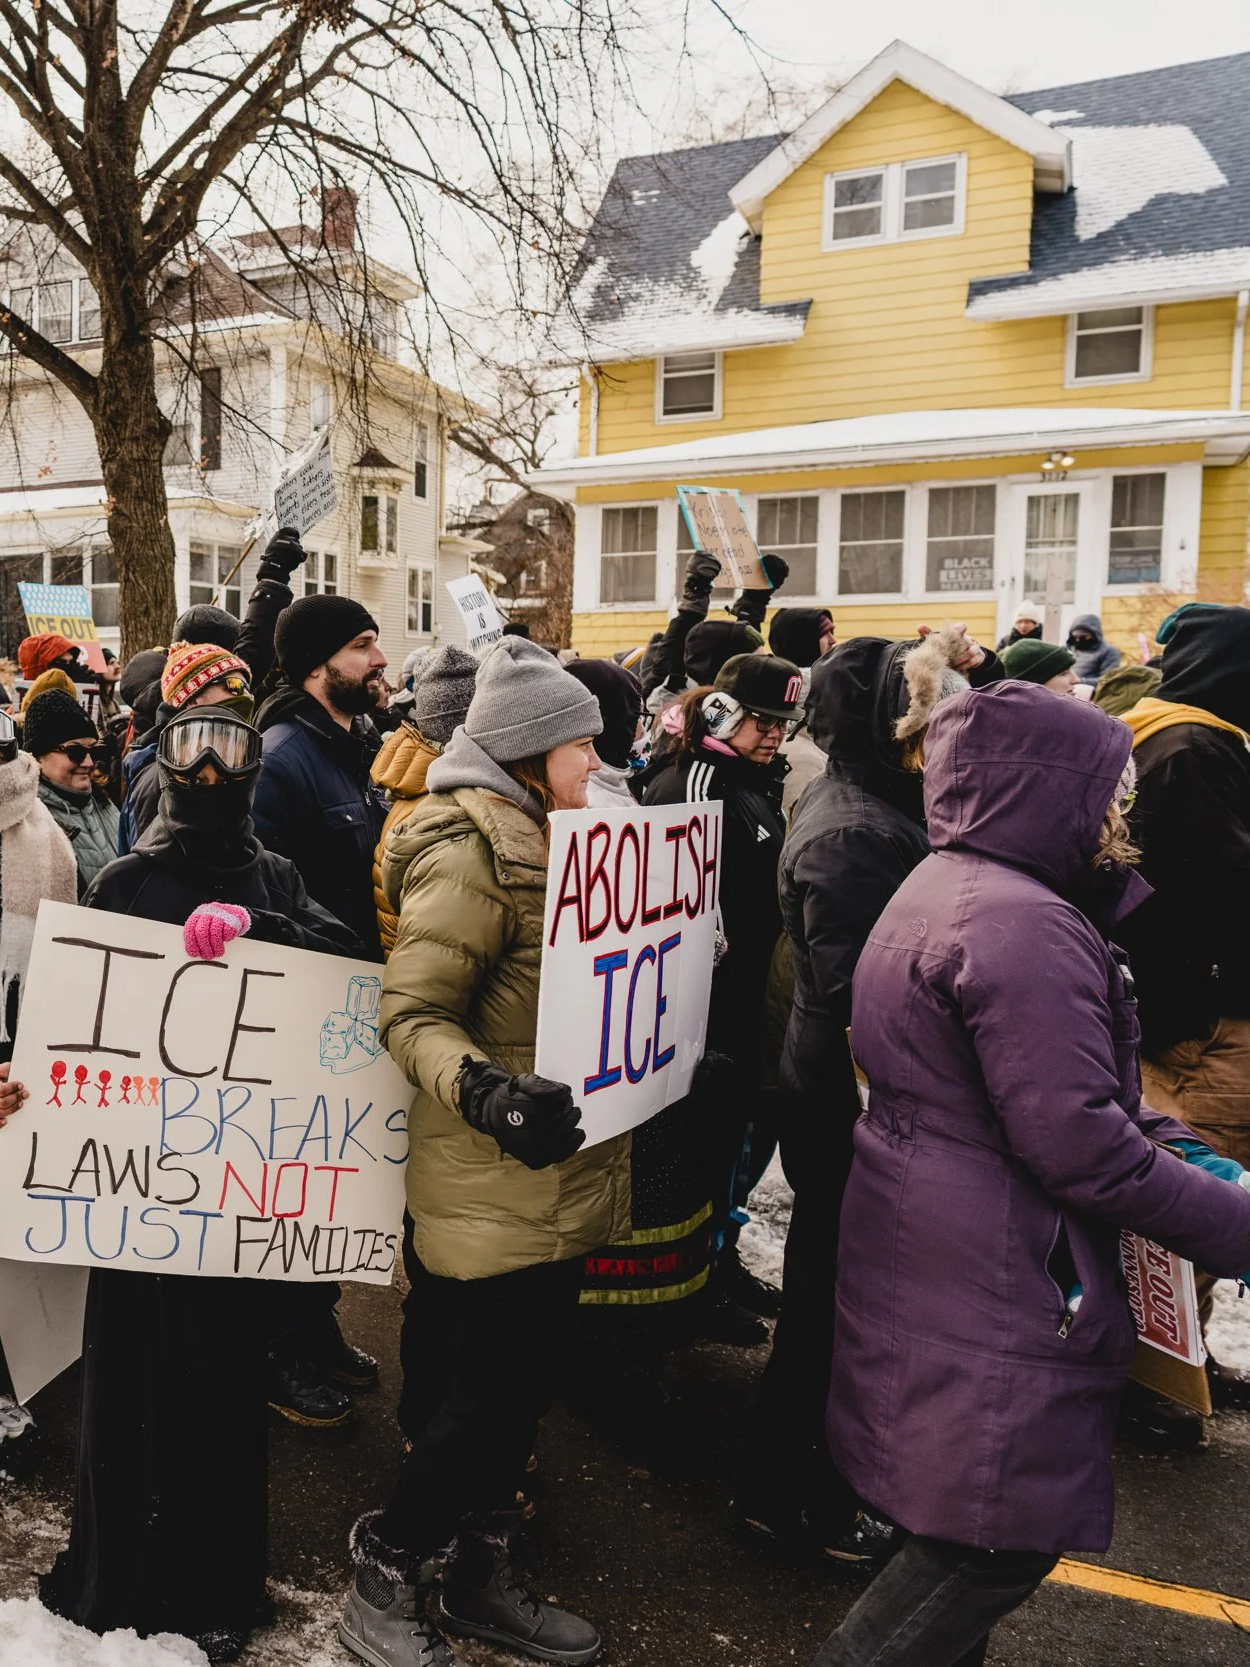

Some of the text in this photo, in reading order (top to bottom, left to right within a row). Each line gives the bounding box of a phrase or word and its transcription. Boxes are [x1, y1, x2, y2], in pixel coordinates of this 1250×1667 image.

[943, 557, 990, 569] BLACK
[946, 569, 987, 580] LIVES
[28, 616, 94, 640] ICE OUT
[458, 590, 488, 613] HISTORY
[477, 612, 487, 630] IS
[470, 628, 502, 652] WATCHING
[548, 813, 719, 948] ABOLISH
[46, 936, 285, 1085] ICE
[582, 931, 682, 1097] ICE
[158, 1076, 409, 1165] BREAKS
[21, 1131, 360, 1222] LAWS NOT
[25, 1192, 399, 1276] JUST FAMILIES
[1147, 1272, 1181, 1345] OUT
